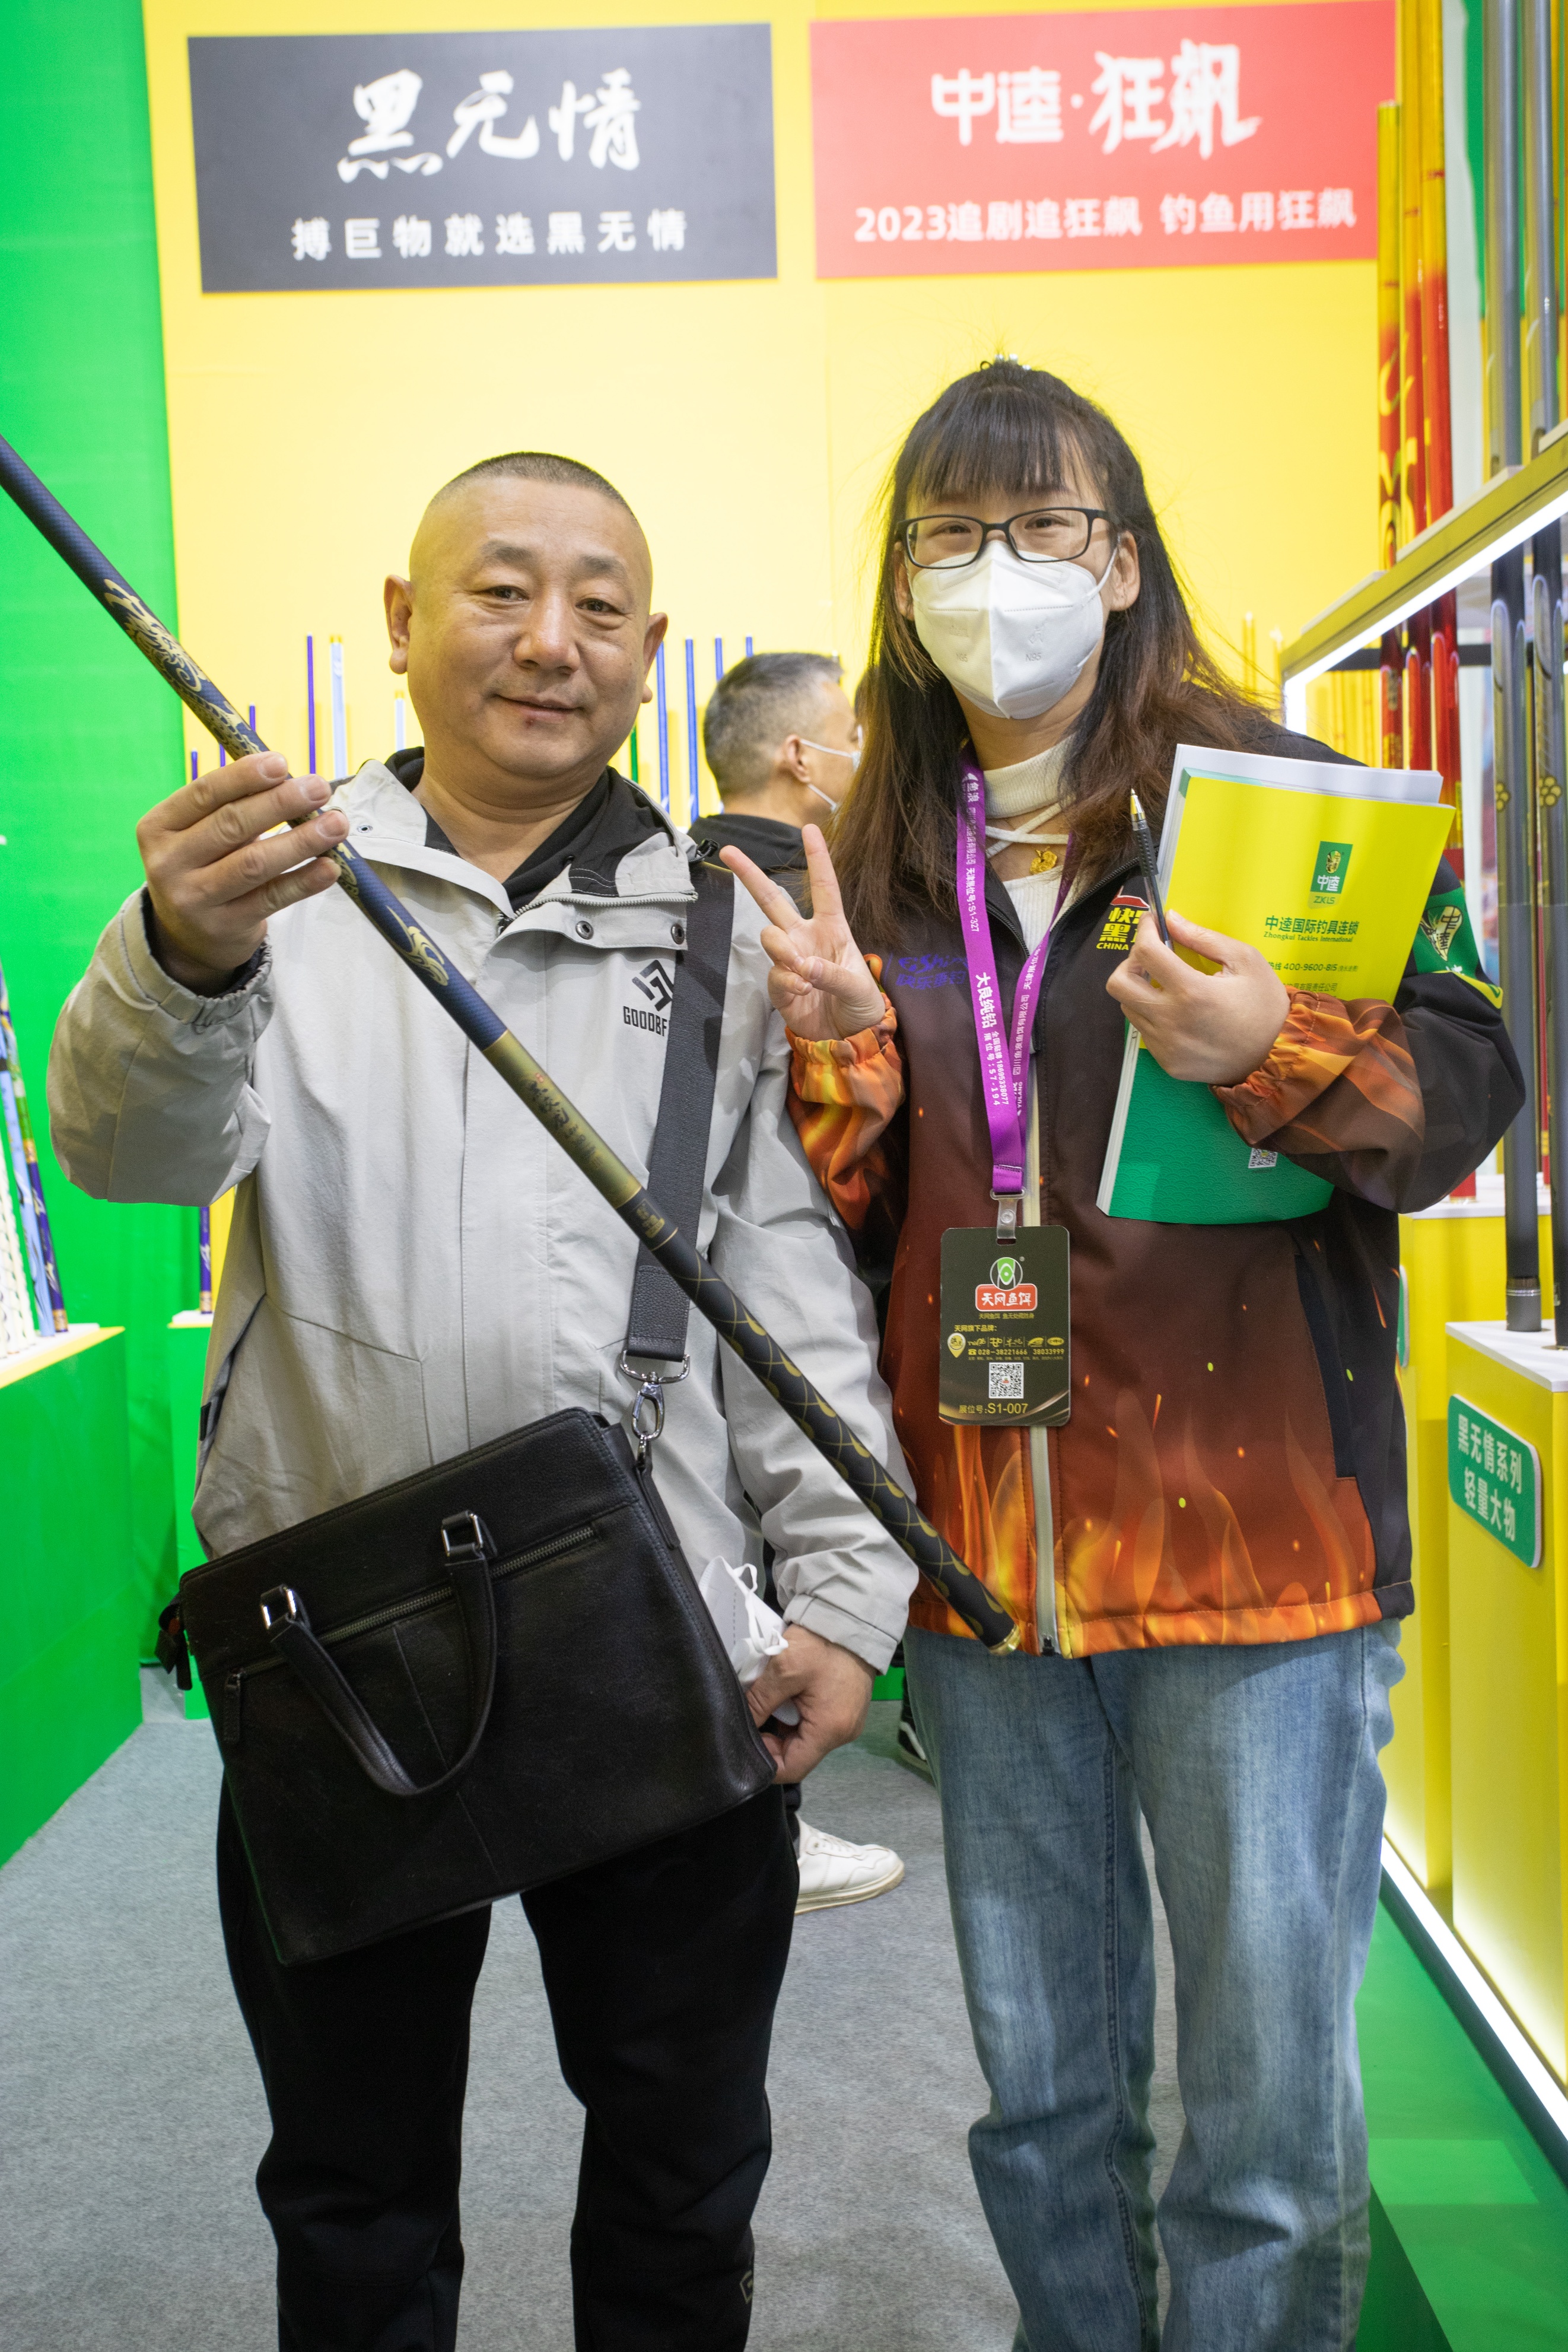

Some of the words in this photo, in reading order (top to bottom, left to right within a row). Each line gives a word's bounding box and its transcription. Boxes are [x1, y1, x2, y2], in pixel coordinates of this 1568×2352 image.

[854, 196, 1143, 242] 2023追剧追狂飙
[1159, 187, 1356, 234] 钓鱼用狂飙
[291, 209, 687, 260] 搏巨物就选黑无情
[1317, 875, 1340, 892] 中逵
[1099, 923, 1138, 943] 黑
[1265, 915, 1360, 936] 中逵国际钓具连锁
[1096, 942, 1130, 951] CHINA
[623, 1006, 670, 1037] GOODBF
[981, 1292, 1032, 1307] 天网鱼饵
[958, 1403, 1029, 1414] 展位号:S1-007
[1457, 1413, 1523, 1495] 黑无情系列
